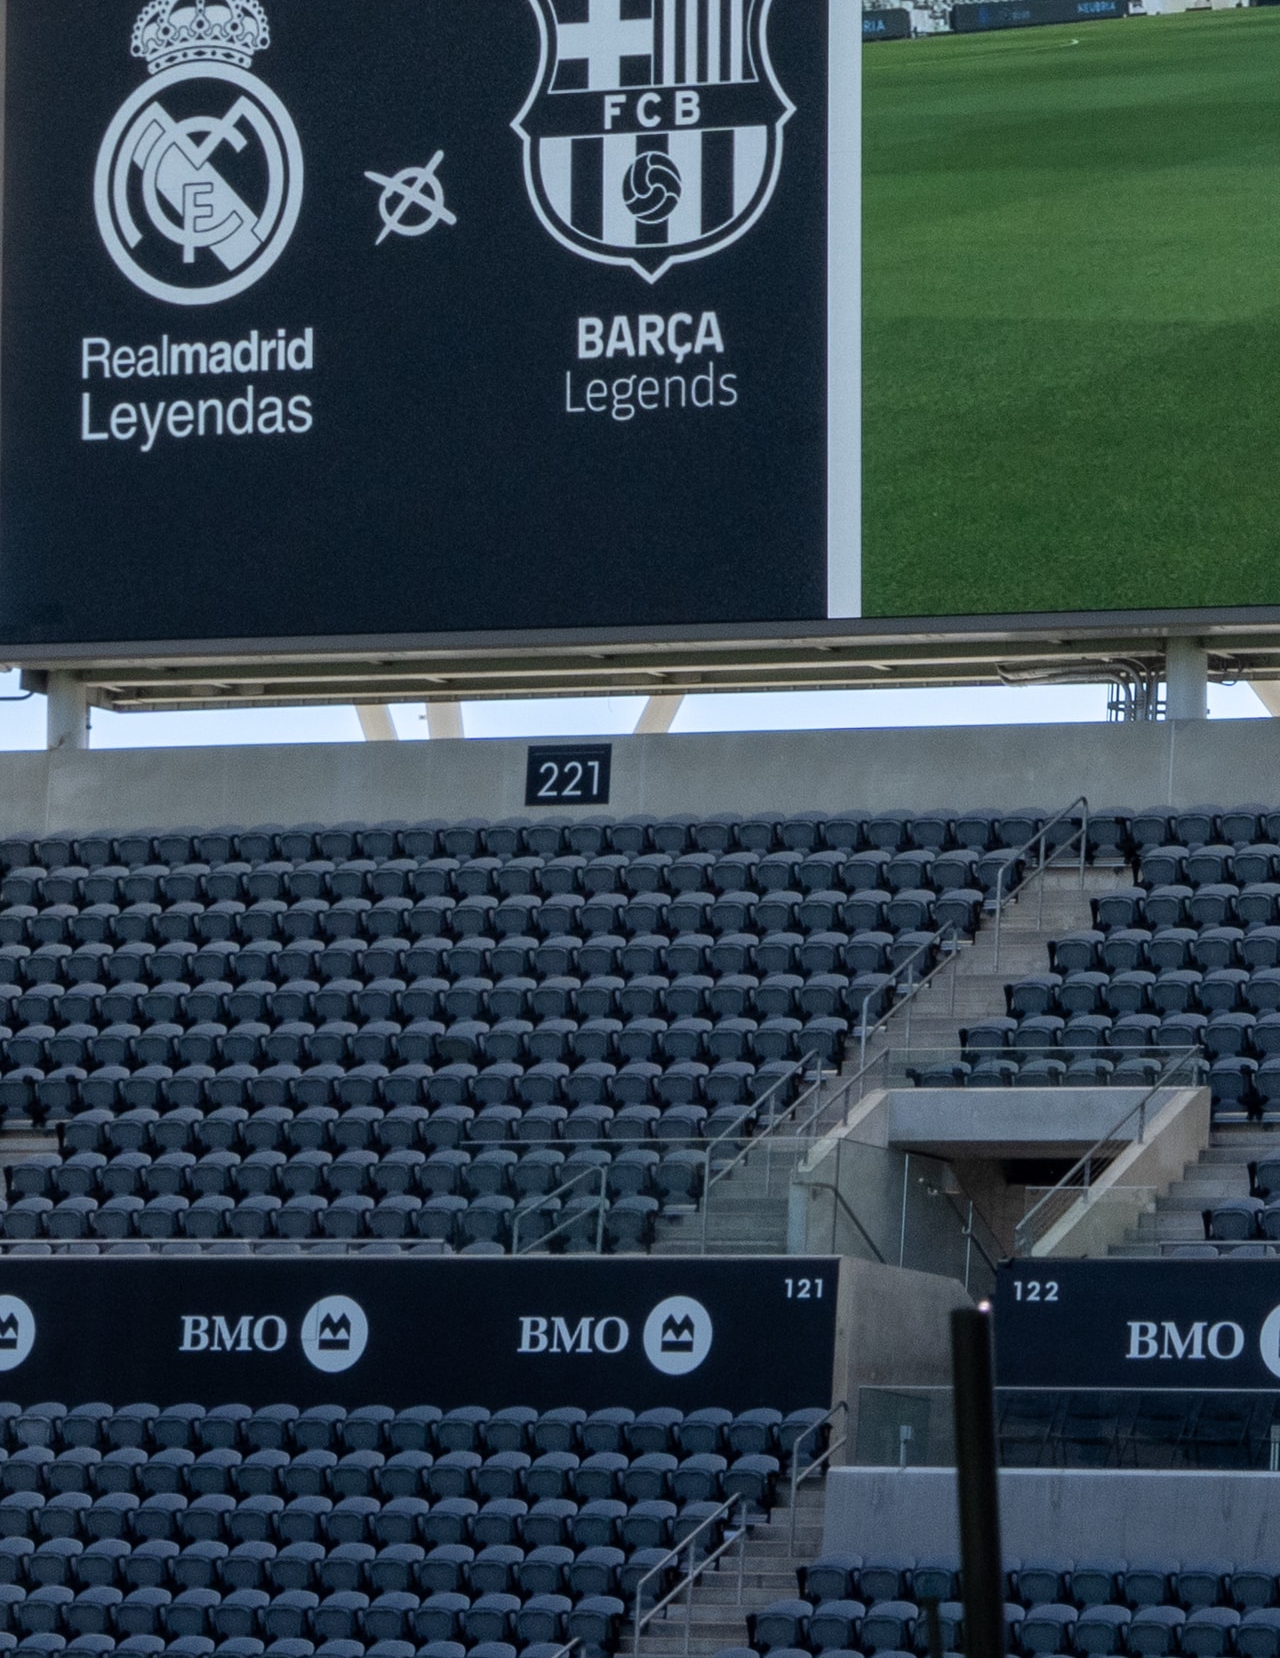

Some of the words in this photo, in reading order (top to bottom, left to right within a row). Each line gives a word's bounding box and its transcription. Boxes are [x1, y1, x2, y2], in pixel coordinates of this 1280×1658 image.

[603, 91, 701, 131] FCB
[83, 328, 313, 378] Realmadrid
[579, 312, 723, 363] BARÇA
[566, 362, 737, 420] Legends
[82, 385, 312, 451] Leyendas
[538, 761, 599, 796] 221
[785, 1279, 822, 1298] 121
[1014, 1281, 1058, 1300] 122
[179, 1315, 287, 1351] BMO
[517, 1317, 629, 1353] BMO
[1126, 1322, 1244, 1359] BMO
